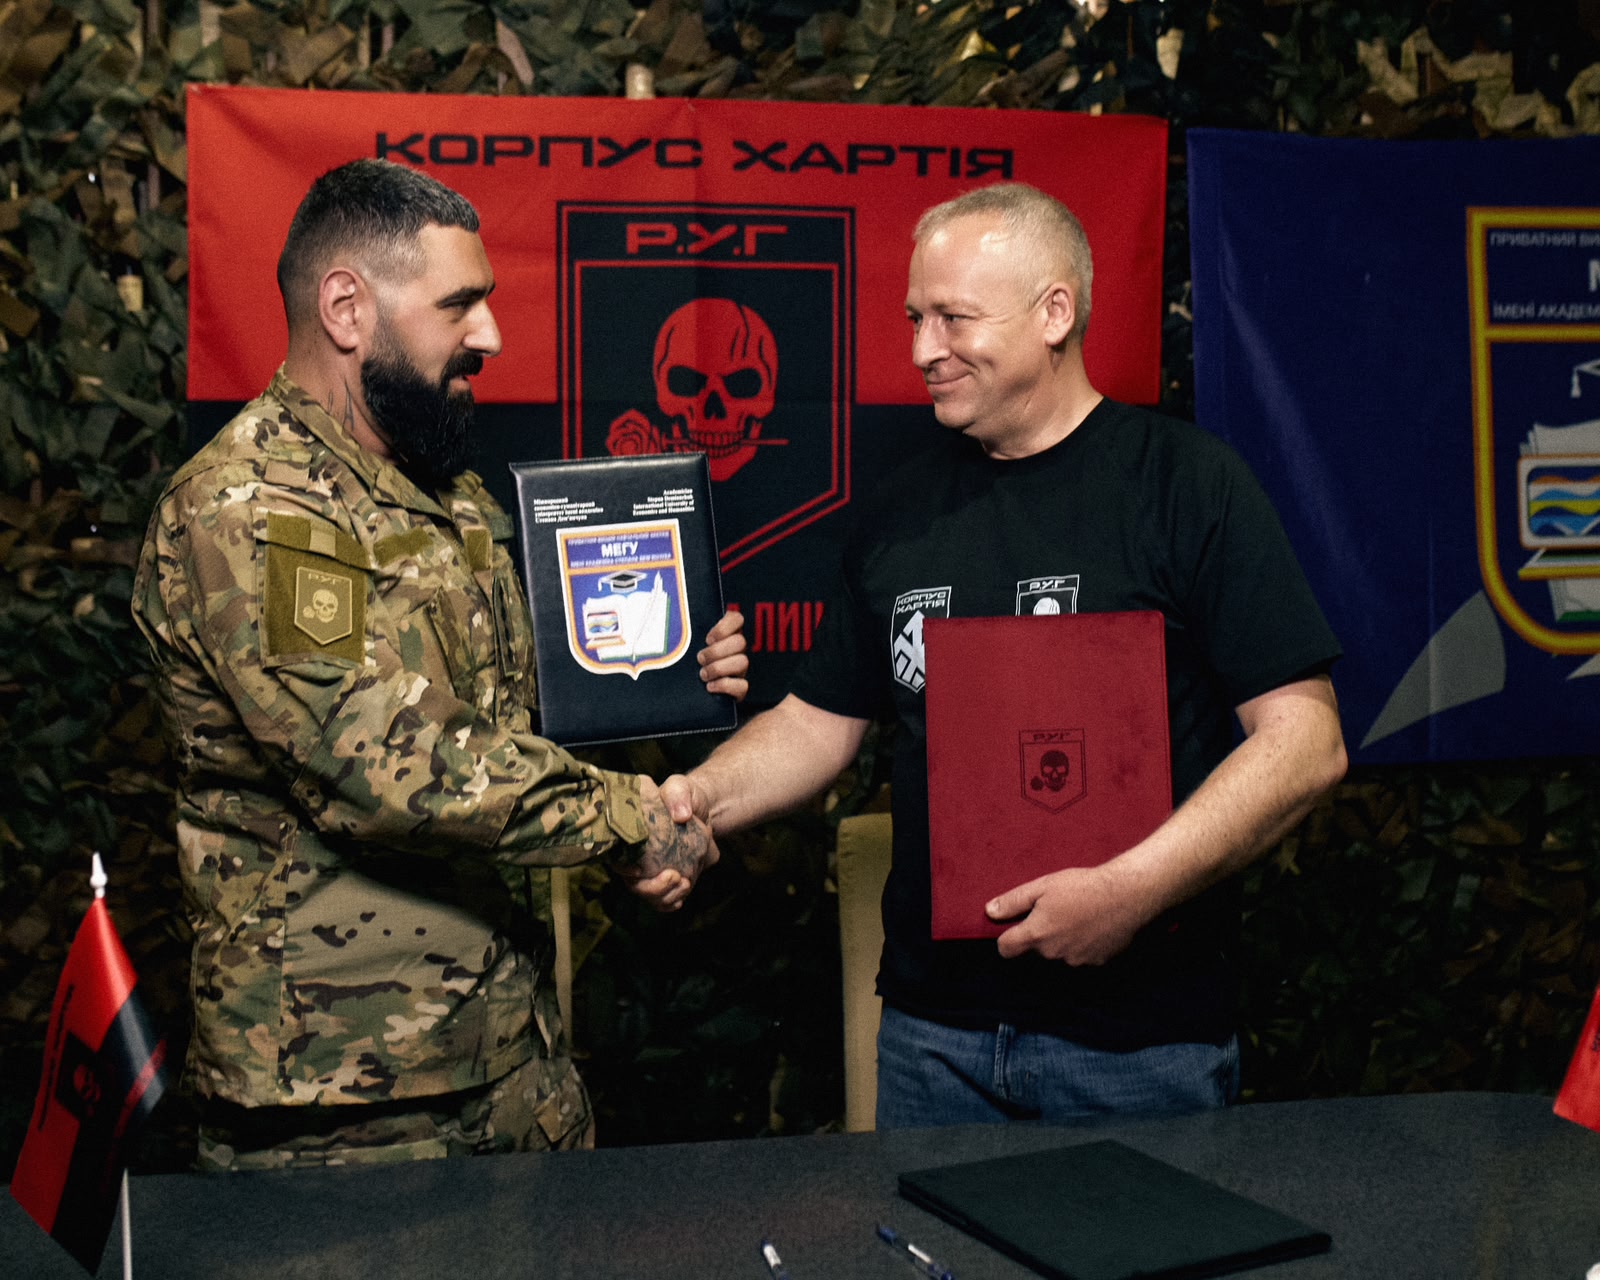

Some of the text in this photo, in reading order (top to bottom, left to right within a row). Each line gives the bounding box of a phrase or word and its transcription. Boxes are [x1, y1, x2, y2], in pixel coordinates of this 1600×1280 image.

[376, 131, 1013, 179] КОРПУС ХАРТІЯ
[625, 222, 788, 256] Р.У.Г
[601, 541, 638, 558] МЕГУ
[895, 598, 946, 615] ХАРТІЯ
[897, 591, 947, 607] КОРПУС
